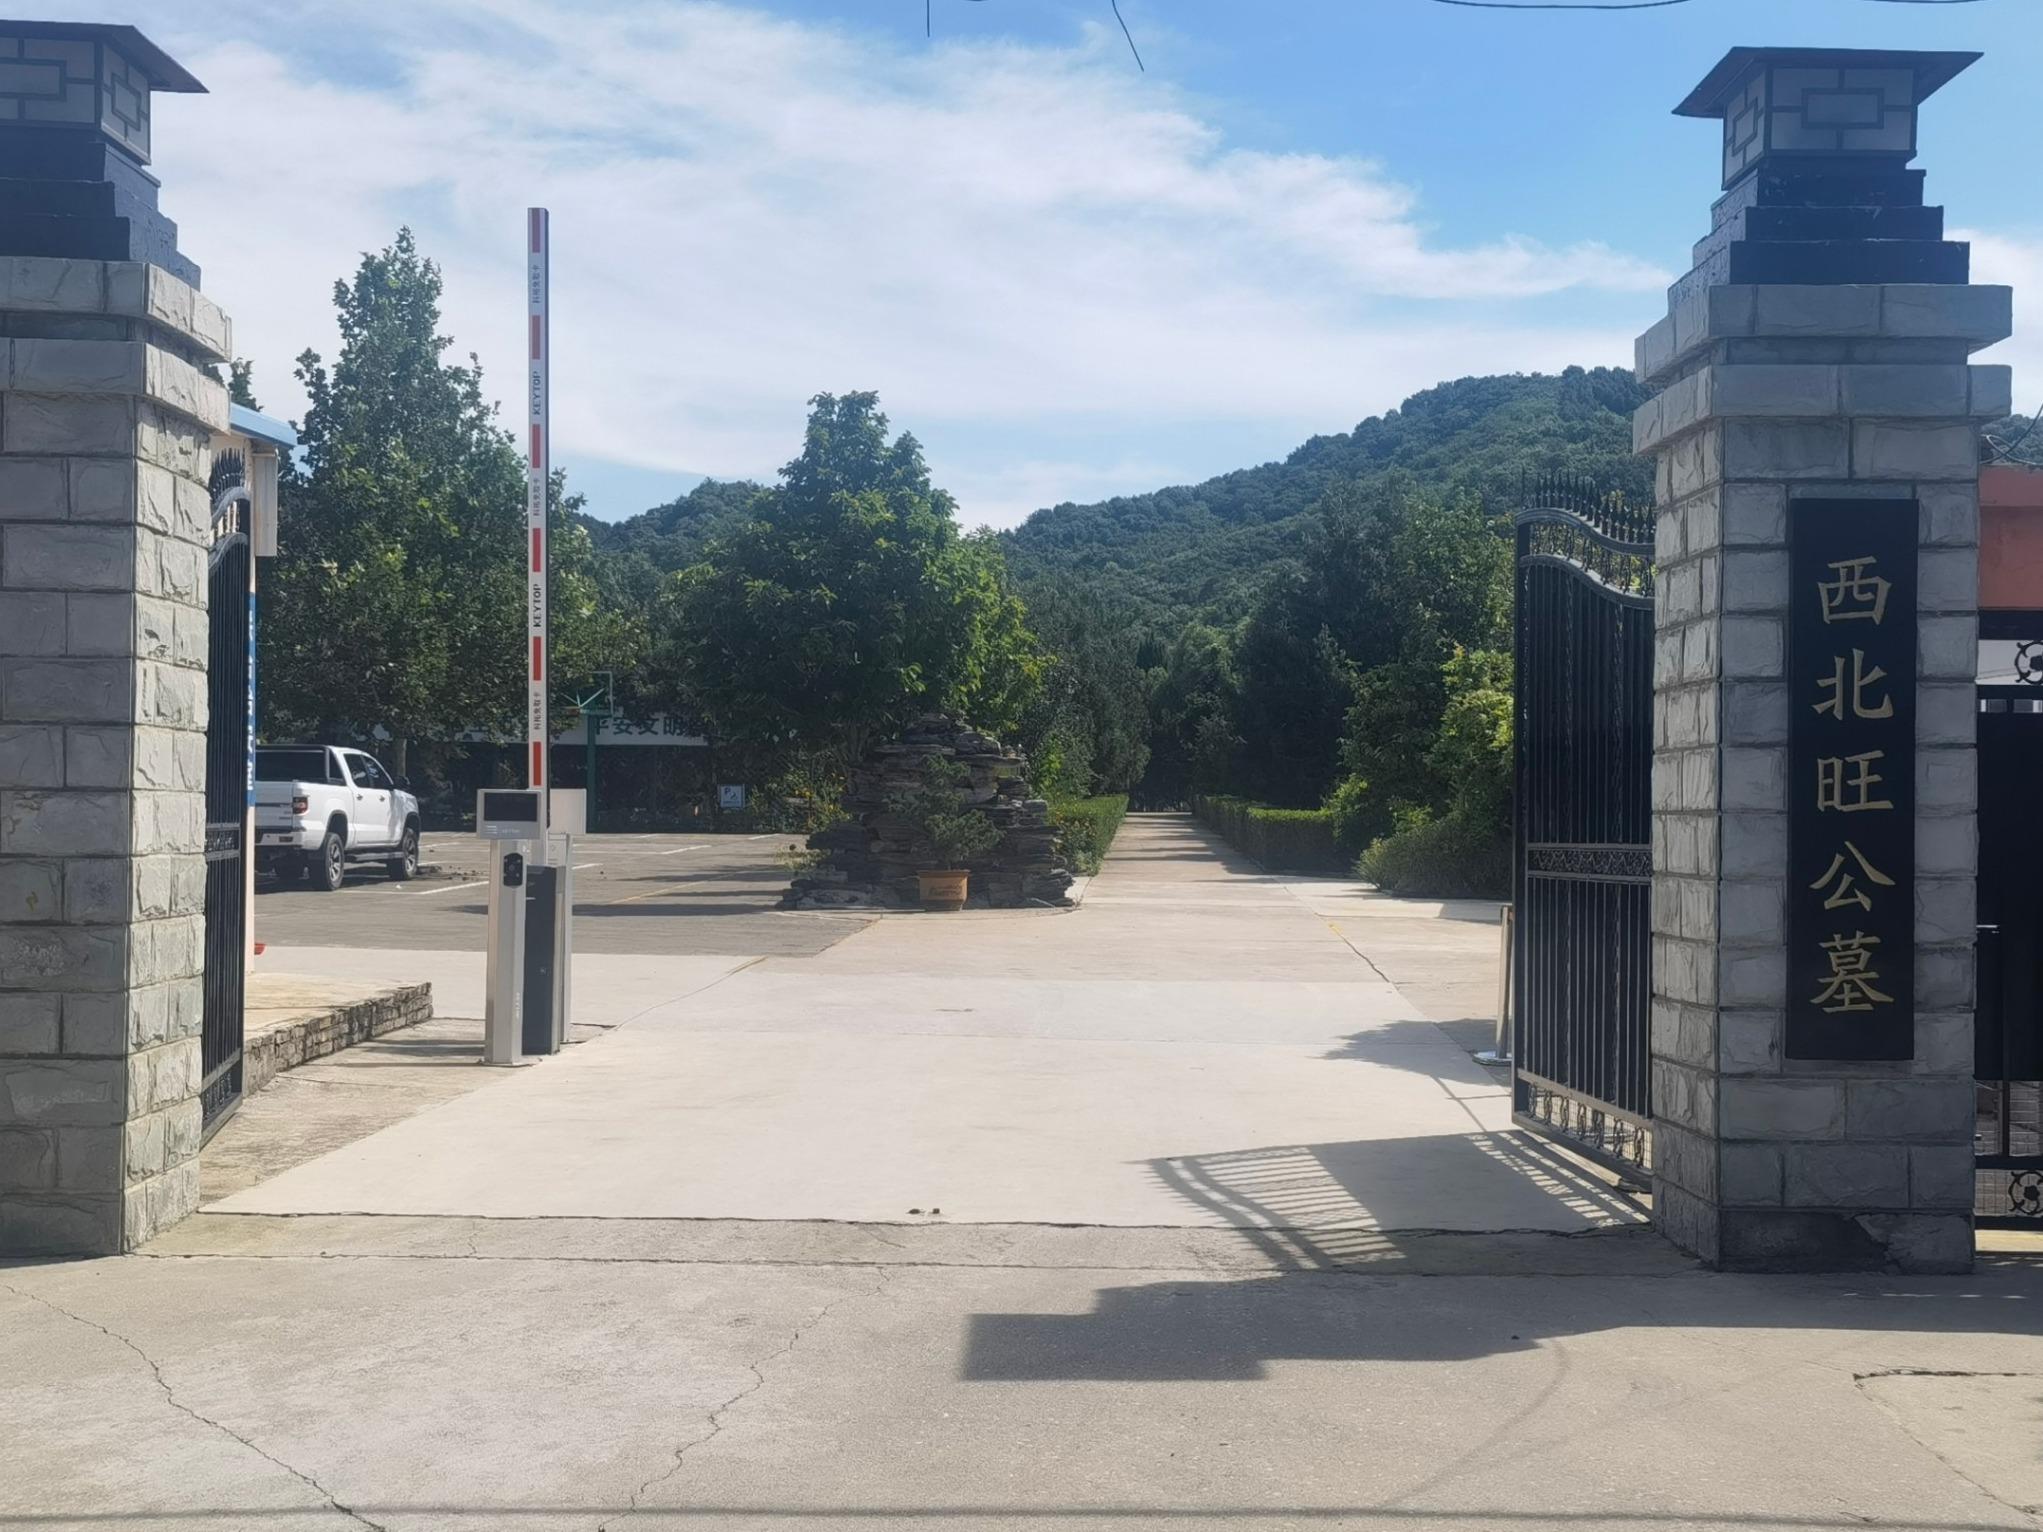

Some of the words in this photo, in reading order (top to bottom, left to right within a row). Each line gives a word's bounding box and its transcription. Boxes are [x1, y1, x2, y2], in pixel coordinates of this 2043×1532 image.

[532, 371, 541, 415] KEYTOP
[533, 583, 542, 628] KEYTOP
[591, 716, 708, 737] 平安文明
[1808, 555, 1896, 1014] 西北旺公墓
